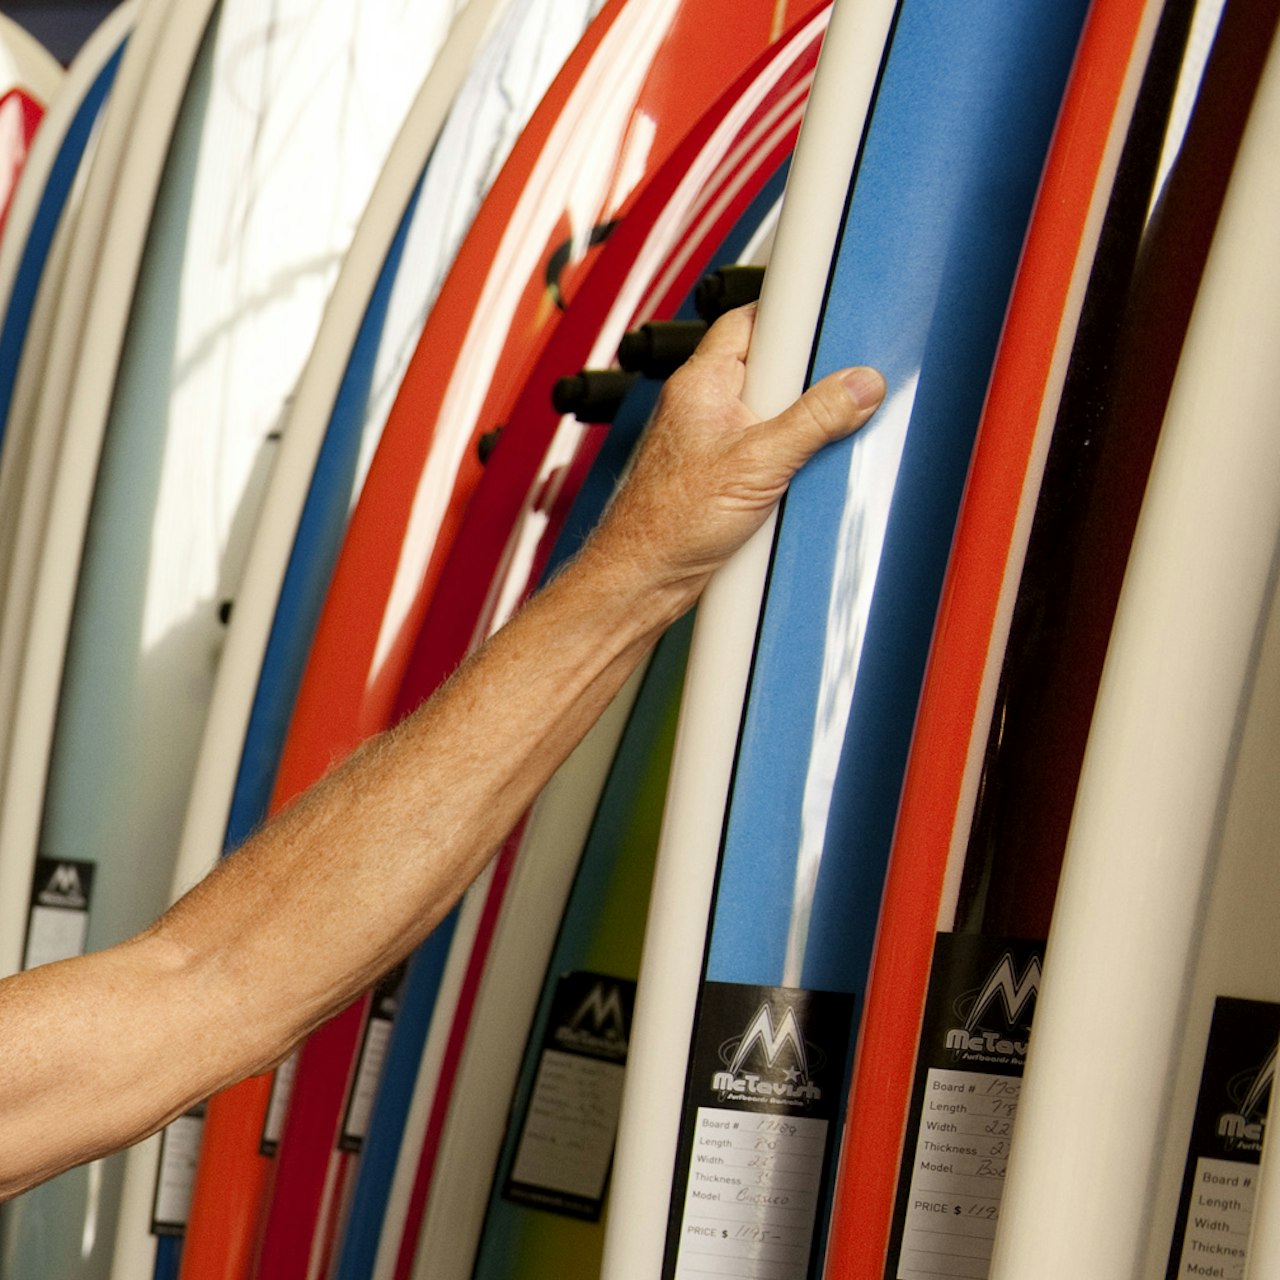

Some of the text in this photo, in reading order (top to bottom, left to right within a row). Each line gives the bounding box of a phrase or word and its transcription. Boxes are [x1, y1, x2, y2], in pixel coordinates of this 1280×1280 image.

[712, 1071, 823, 1101] McTavish
[932, 1080, 966, 1093] Board
[929, 1101, 968, 1115] Length
[702, 1118, 730, 1130] Board
[926, 1121, 958, 1133] Width
[699, 1137, 733, 1148] Length
[923, 1141, 978, 1156] Thickness
[697, 1154, 724, 1165] Width
[920, 1161, 955, 1174] Model
[695, 1172, 742, 1186] Thickness
[1202, 1171, 1239, 1187] Board
[692, 1190, 721, 1201] Model
[913, 1200, 949, 1214] PRICE
[953, 1205, 962, 1217] $
[1197, 1195, 1242, 1212] Length
[1194, 1217, 1230, 1233] Width
[687, 1225, 717, 1238] PRICE
[721, 1229, 729, 1240] $
[1186, 1262, 1224, 1279] Model
